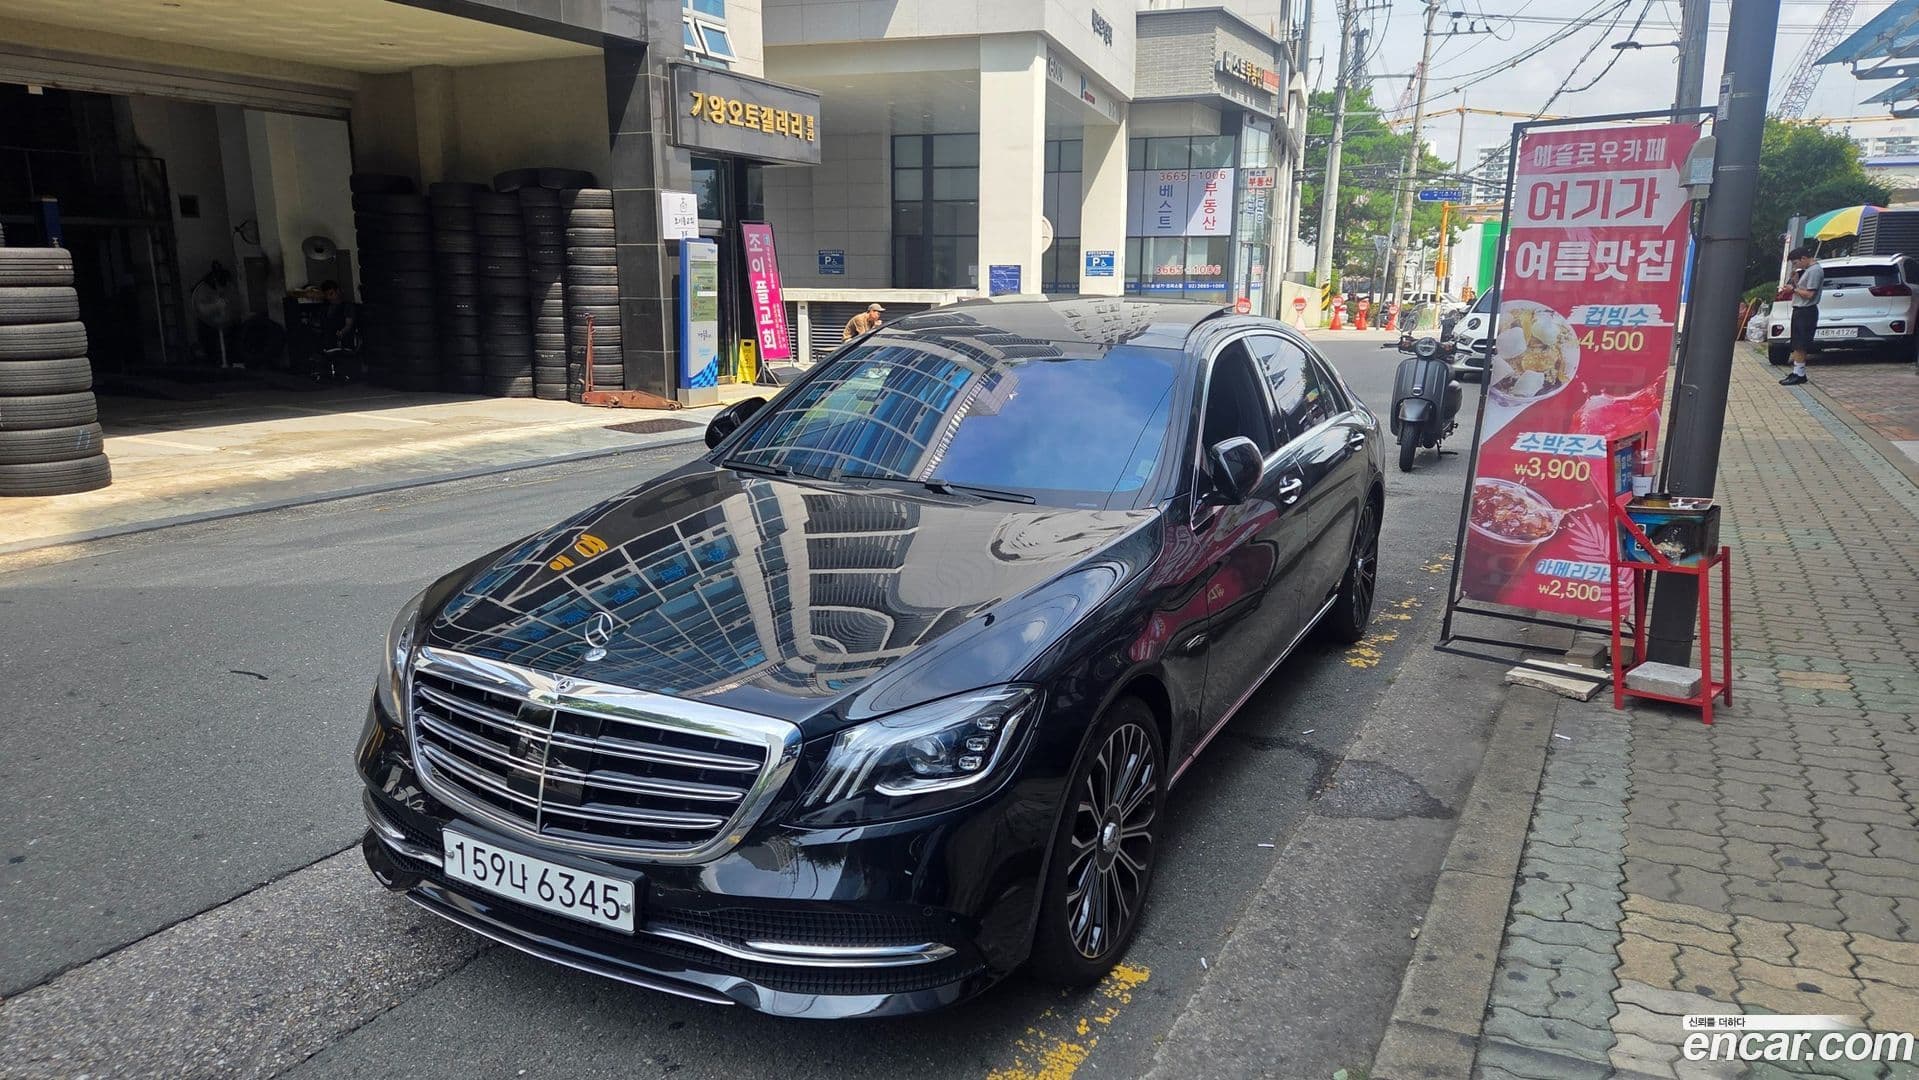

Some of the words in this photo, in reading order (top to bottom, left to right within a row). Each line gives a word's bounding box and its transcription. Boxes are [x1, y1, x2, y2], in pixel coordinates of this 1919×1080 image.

[690, 90, 804, 139] 기양오토갤러리
[1159, 170, 1227, 181] 3665-1006
[1248, 177, 1273, 187] 부동산
[1157, 184, 1174, 229] 베스트
[1202, 182, 1218, 231] 부동산
[1528, 177, 1661, 220] 여기가
[825, 256, 832, 265] P
[1093, 257, 1100, 267] P
[1515, 240, 1676, 282] 여름맛집
[749, 233, 777, 350] 조이플교회
[1584, 306, 1649, 328] 컵빙수
[1536, 559, 1612, 582] 아메리카
[455, 841, 529, 894] 159나
[537, 868, 621, 921] 6345
